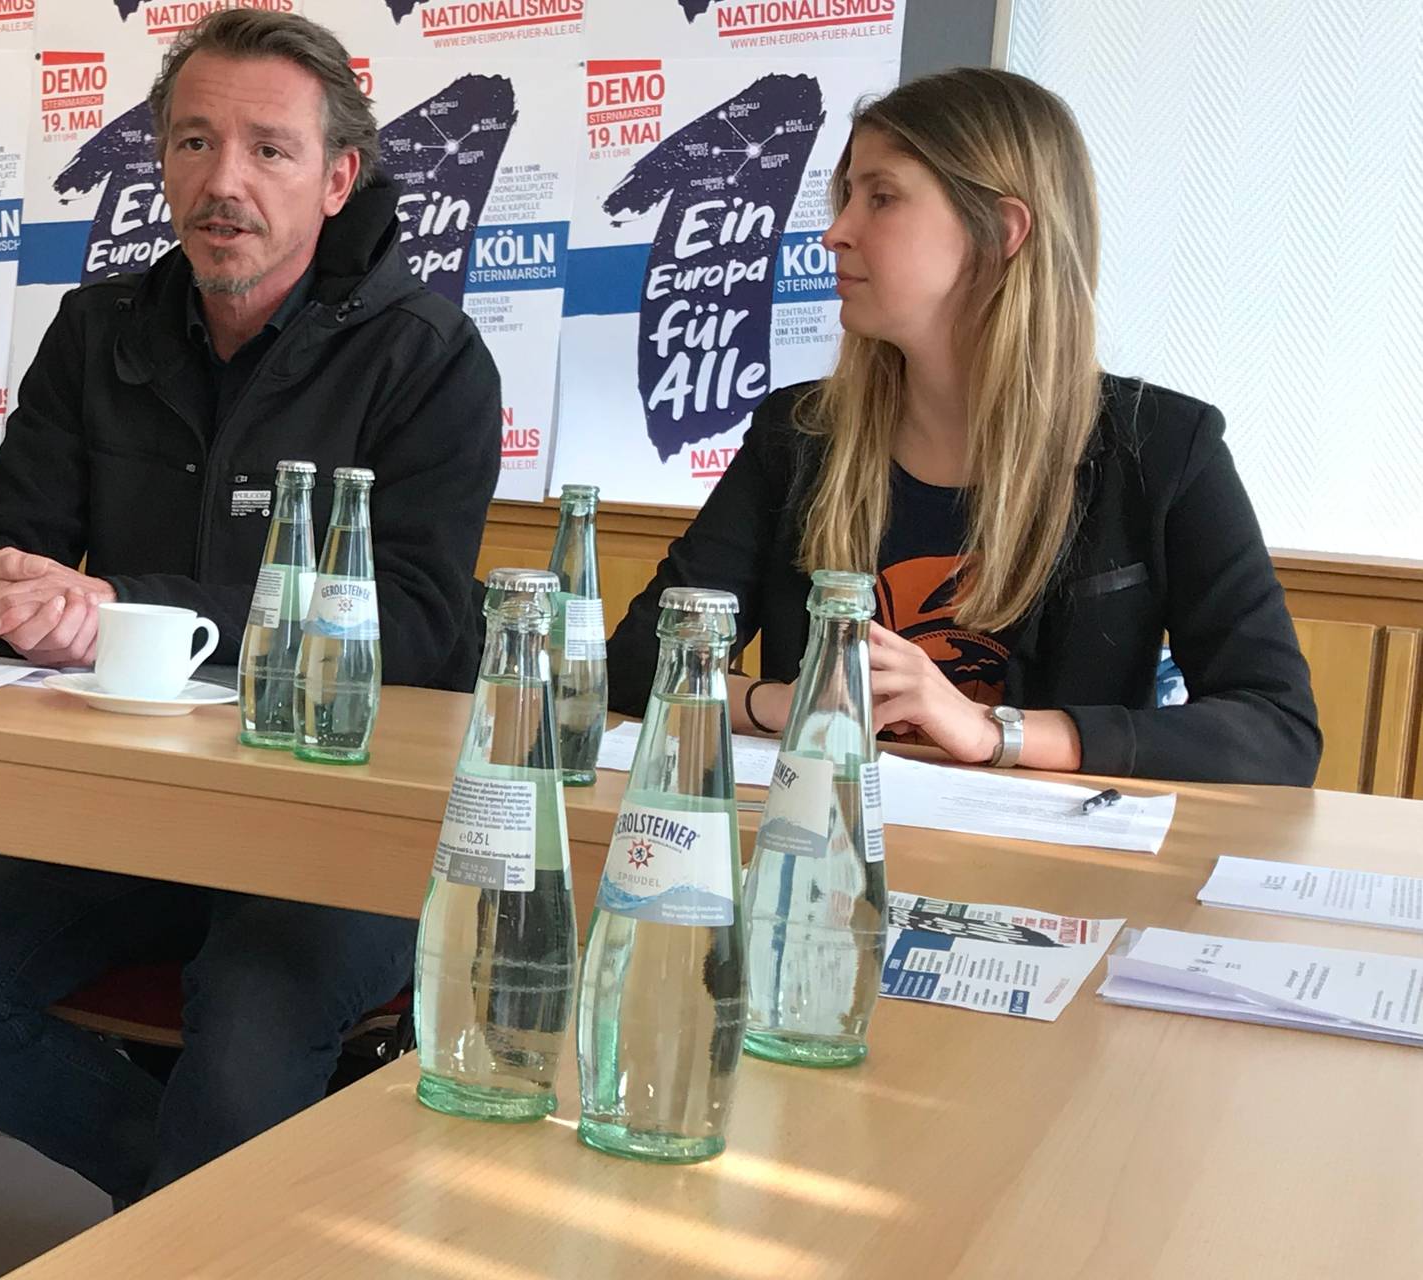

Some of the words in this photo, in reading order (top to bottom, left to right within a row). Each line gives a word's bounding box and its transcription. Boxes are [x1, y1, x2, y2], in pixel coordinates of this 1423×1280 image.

[730, 24, 892, 49] WWW.EIN-EUROPA-FUER-ALLE.DE
[42, 65, 107, 94] DEMO
[587, 74, 665, 107] DEMO
[42, 113, 65, 132] 19.
[69, 110, 103, 131] MAI
[589, 106, 659, 124] STERNMARSCH
[587, 127, 616, 149] 19.
[621, 121, 661, 146] MAI
[589, 151, 600, 160] AB
[603, 150, 611, 158] 11
[613, 148, 631, 157] UHR
[500, 166, 513, 174] UM
[524, 164, 540, 172] UHR
[808, 169, 821, 178] UM
[804, 179, 823, 188] VON
[675, 196, 776, 259] Ein
[86, 237, 181, 272] Europ
[475, 229, 554, 268] KÖLN
[469, 266, 556, 284] STERNMARSCH
[645, 256, 769, 300] Europa
[777, 276, 838, 293] STERNMA
[775, 315, 827, 326] TREFFPUNKT
[776, 306, 823, 317] ZENTRALER
[648, 299, 750, 358] für
[775, 328, 788, 336] UM
[790, 327, 799, 335] 12
[801, 326, 817, 334] UHR
[647, 347, 767, 420] Alle
